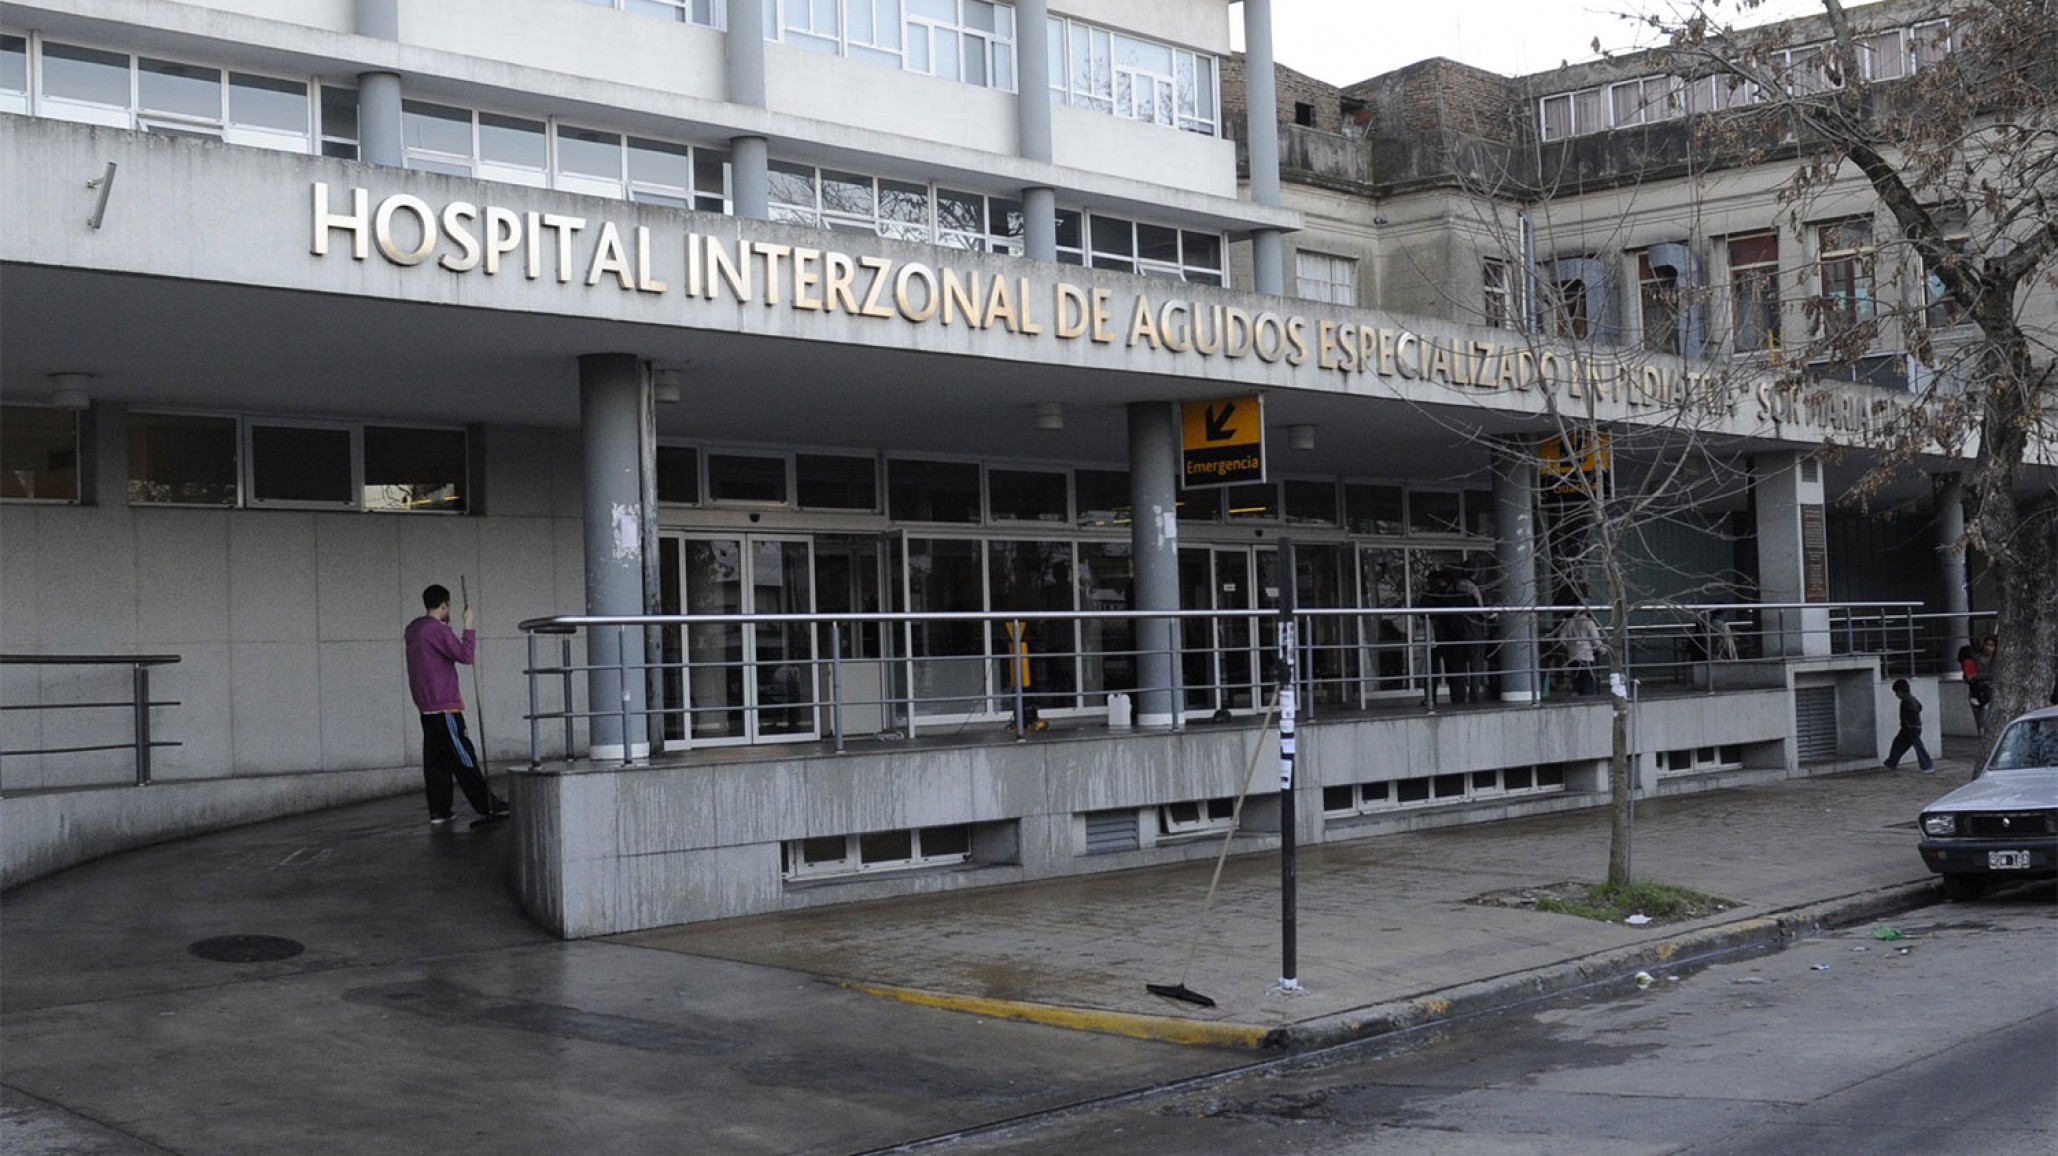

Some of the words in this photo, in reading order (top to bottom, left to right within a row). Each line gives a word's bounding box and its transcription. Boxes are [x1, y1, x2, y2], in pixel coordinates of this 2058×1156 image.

[310, 182, 668, 293] HOSPITAL
[685, 231, 1042, 335] INTERZONAL
[1054, 282, 1115, 344] DE
[1127, 294, 1306, 367] AGUDOS
[1316, 319, 1560, 391] ESPECIALIZADO
[1186, 455, 1259, 476] Emergencia
